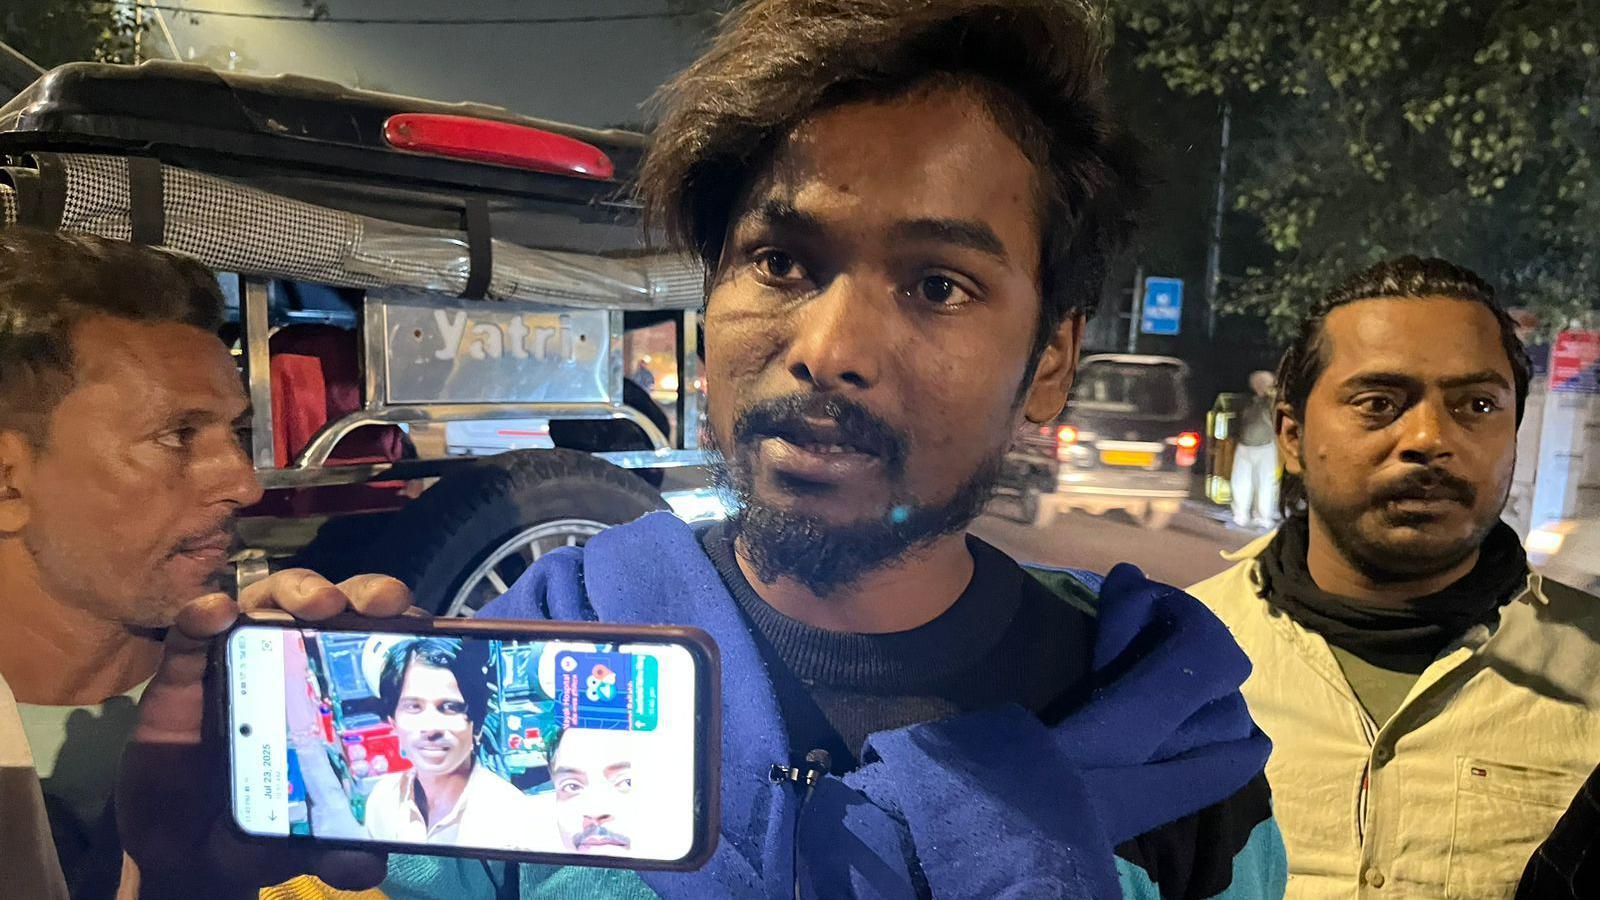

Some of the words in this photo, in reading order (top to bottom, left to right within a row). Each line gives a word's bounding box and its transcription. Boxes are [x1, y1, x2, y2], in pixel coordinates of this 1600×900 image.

[433, 309, 572, 360] Yatri
[562, 673, 571, 706] Hospital
[262, 743, 271, 767] 2025
[263, 770, 273, 784] 23,
[263, 785, 272, 800] Jul
